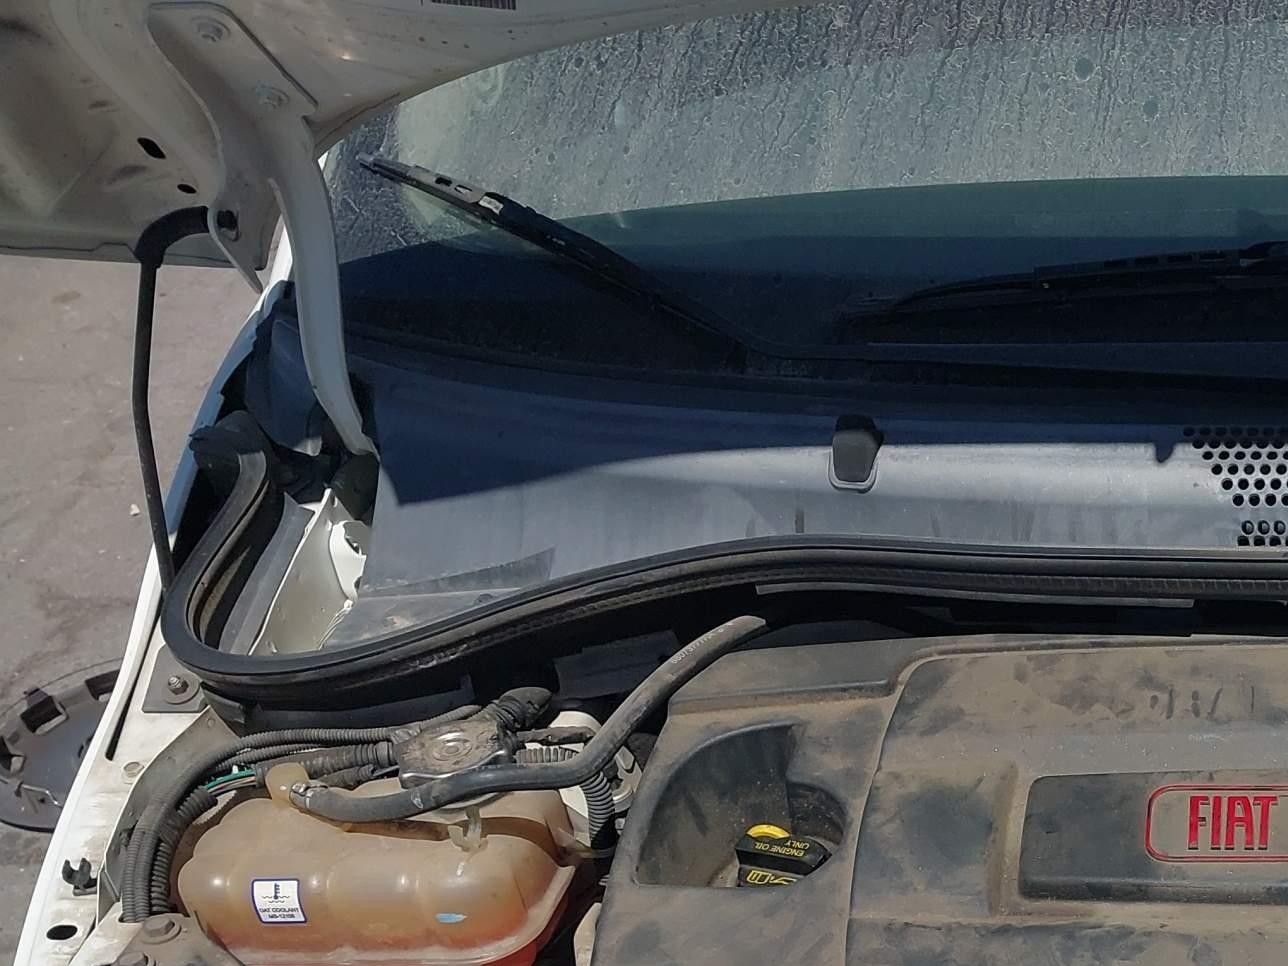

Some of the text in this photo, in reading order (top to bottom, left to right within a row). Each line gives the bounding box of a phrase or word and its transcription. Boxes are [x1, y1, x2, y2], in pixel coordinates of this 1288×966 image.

[1187, 796, 1278, 850] FIAT
[754, 842, 805, 857] ENGINE OIL
[784, 840, 810, 849] ONLY
